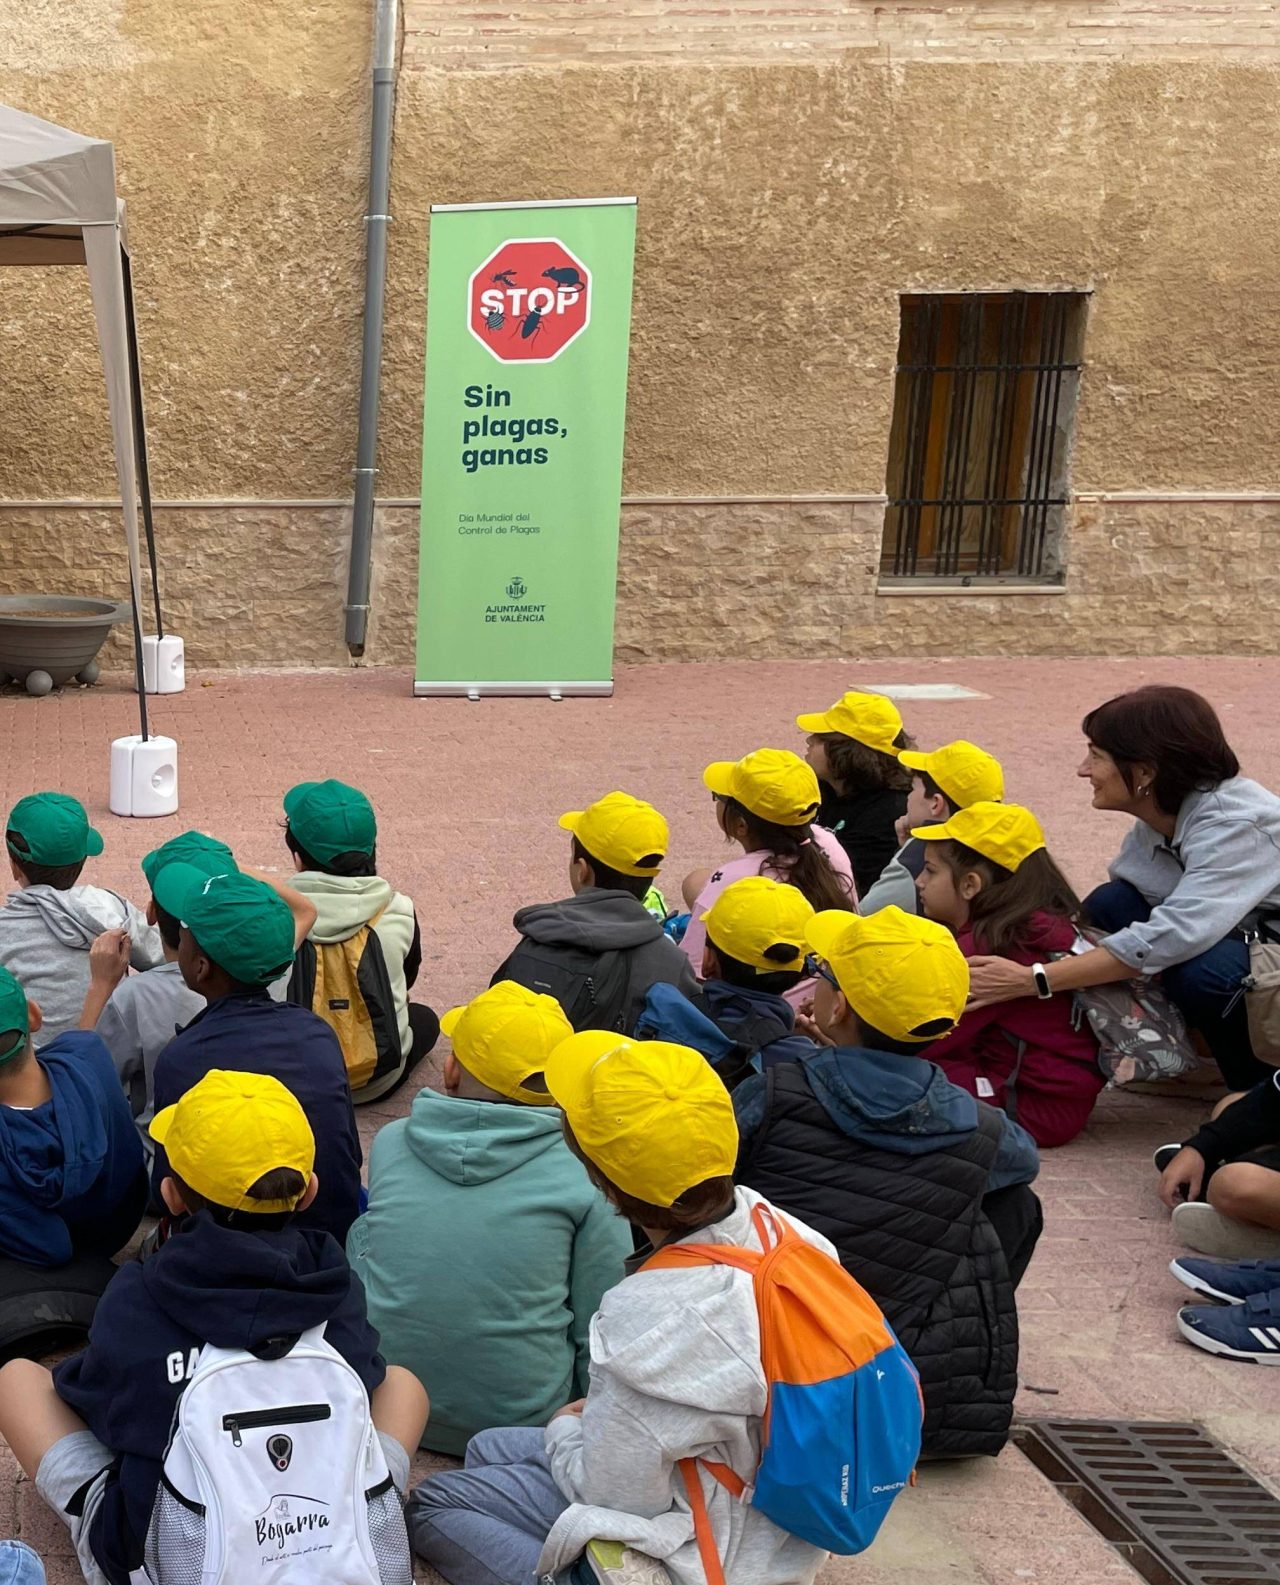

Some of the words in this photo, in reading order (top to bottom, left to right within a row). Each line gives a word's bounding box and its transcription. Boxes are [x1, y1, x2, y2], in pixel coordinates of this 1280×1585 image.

[480, 286, 580, 317] STOP
[464, 384, 511, 408] Sin
[463, 415, 568, 444] plagas,
[462, 447, 549, 473] ganas
[458, 526, 492, 535] Control
[495, 526, 507, 534] de
[510, 525, 541, 535] Plagas
[477, 513, 513, 522] Mundial
[516, 513, 530, 521] del
[485, 605, 546, 613] AJUNTAMENT
[255, 1513, 330, 1550] Bogarra
